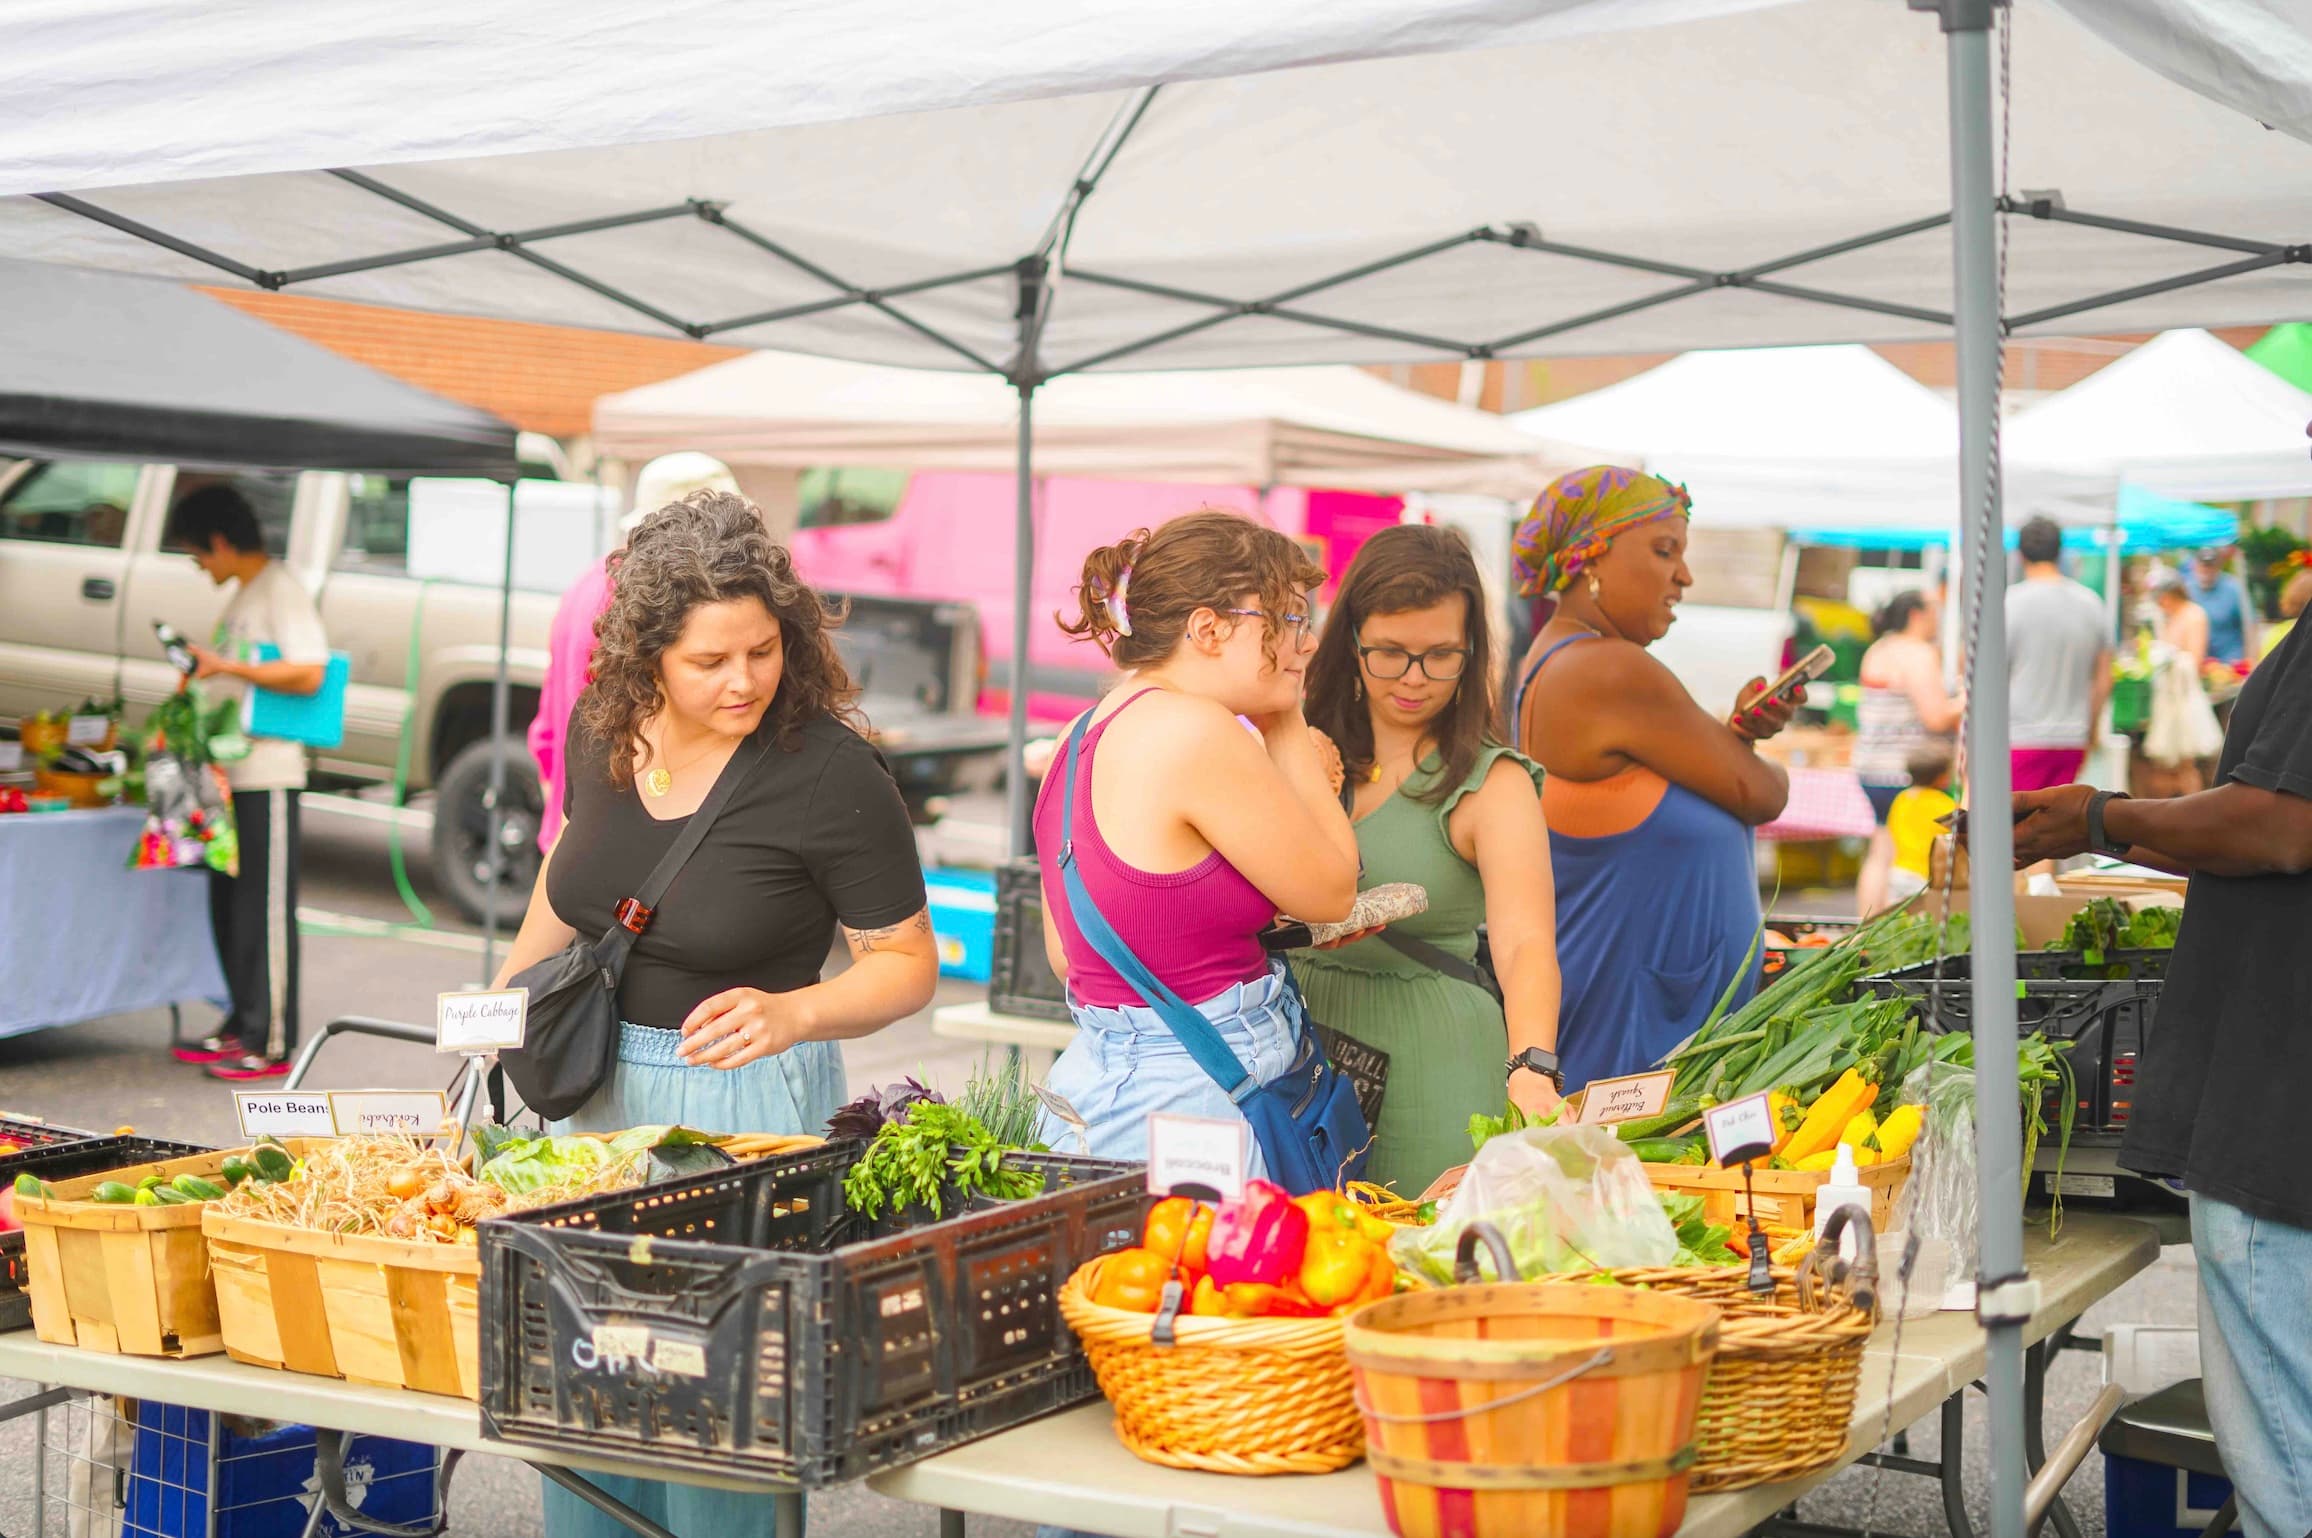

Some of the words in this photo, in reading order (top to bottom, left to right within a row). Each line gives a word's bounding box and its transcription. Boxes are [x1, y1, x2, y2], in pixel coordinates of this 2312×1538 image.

[445, 1003, 477, 1026] Purple
[480, 1001, 519, 1021] Cabbage
[1609, 1082, 1644, 1103] Squash
[247, 1102, 282, 1114] Pole
[1599, 1101, 1646, 1118] Butternut
